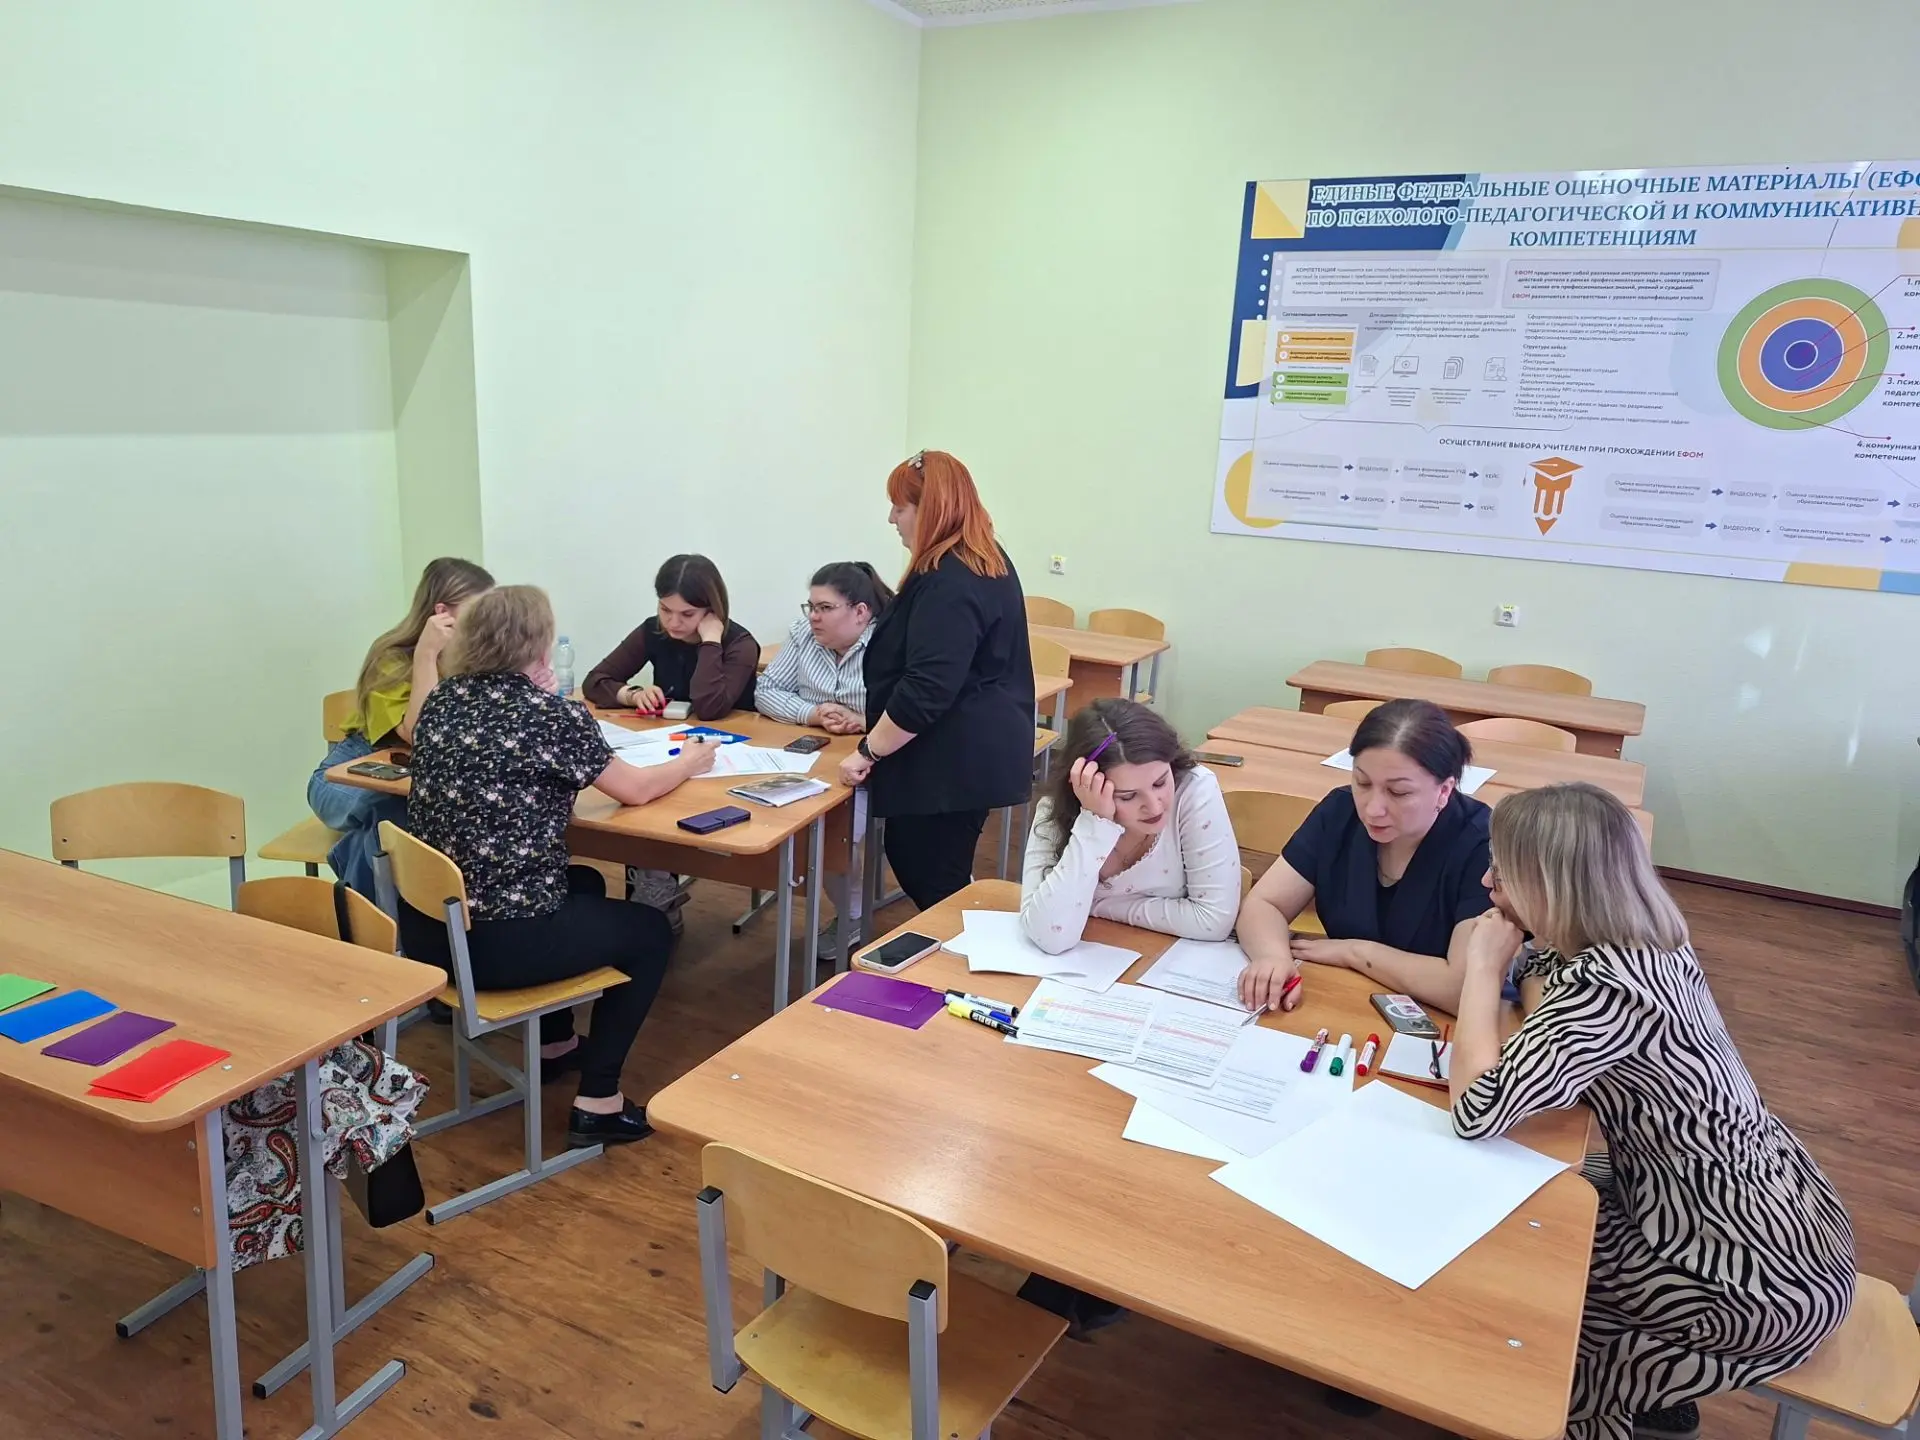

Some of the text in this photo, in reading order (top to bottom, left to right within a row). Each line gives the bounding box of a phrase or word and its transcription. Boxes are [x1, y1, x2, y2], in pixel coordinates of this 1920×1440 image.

[1312, 183, 1395, 205] ЕДИНЫЕ
[1398, 180, 1550, 203] ФЕДЕРАЛЬНЫЕ
[1555, 176, 1700, 198] ОЦЕНОЧНЫЕ
[1706, 172, 1861, 192] МАТЕРИАЛЫ
[1308, 208, 1335, 227] ПО
[1338, 201, 1667, 226] ПСИХОЛОГО-ПЕДАГОГИЧЕСКОЙ
[1672, 203, 1688, 220] И
[1509, 229, 1697, 248] КОМПЕТЕНЦИЯМ
[1897, 331, 1905, 339] 2.
[1887, 377, 1895, 385] 3.
[1439, 438, 1704, 458] ОСУЩЕСТВЛЕНИЕ ВЫБОРА УЧИТЕЛЕМ ПРИ ПРОХОЖДЕНИИ ЕФОМ
[1854, 452, 1916, 461] компетенции
[1723, 524, 1760, 532] ВИДЕОУРОК
